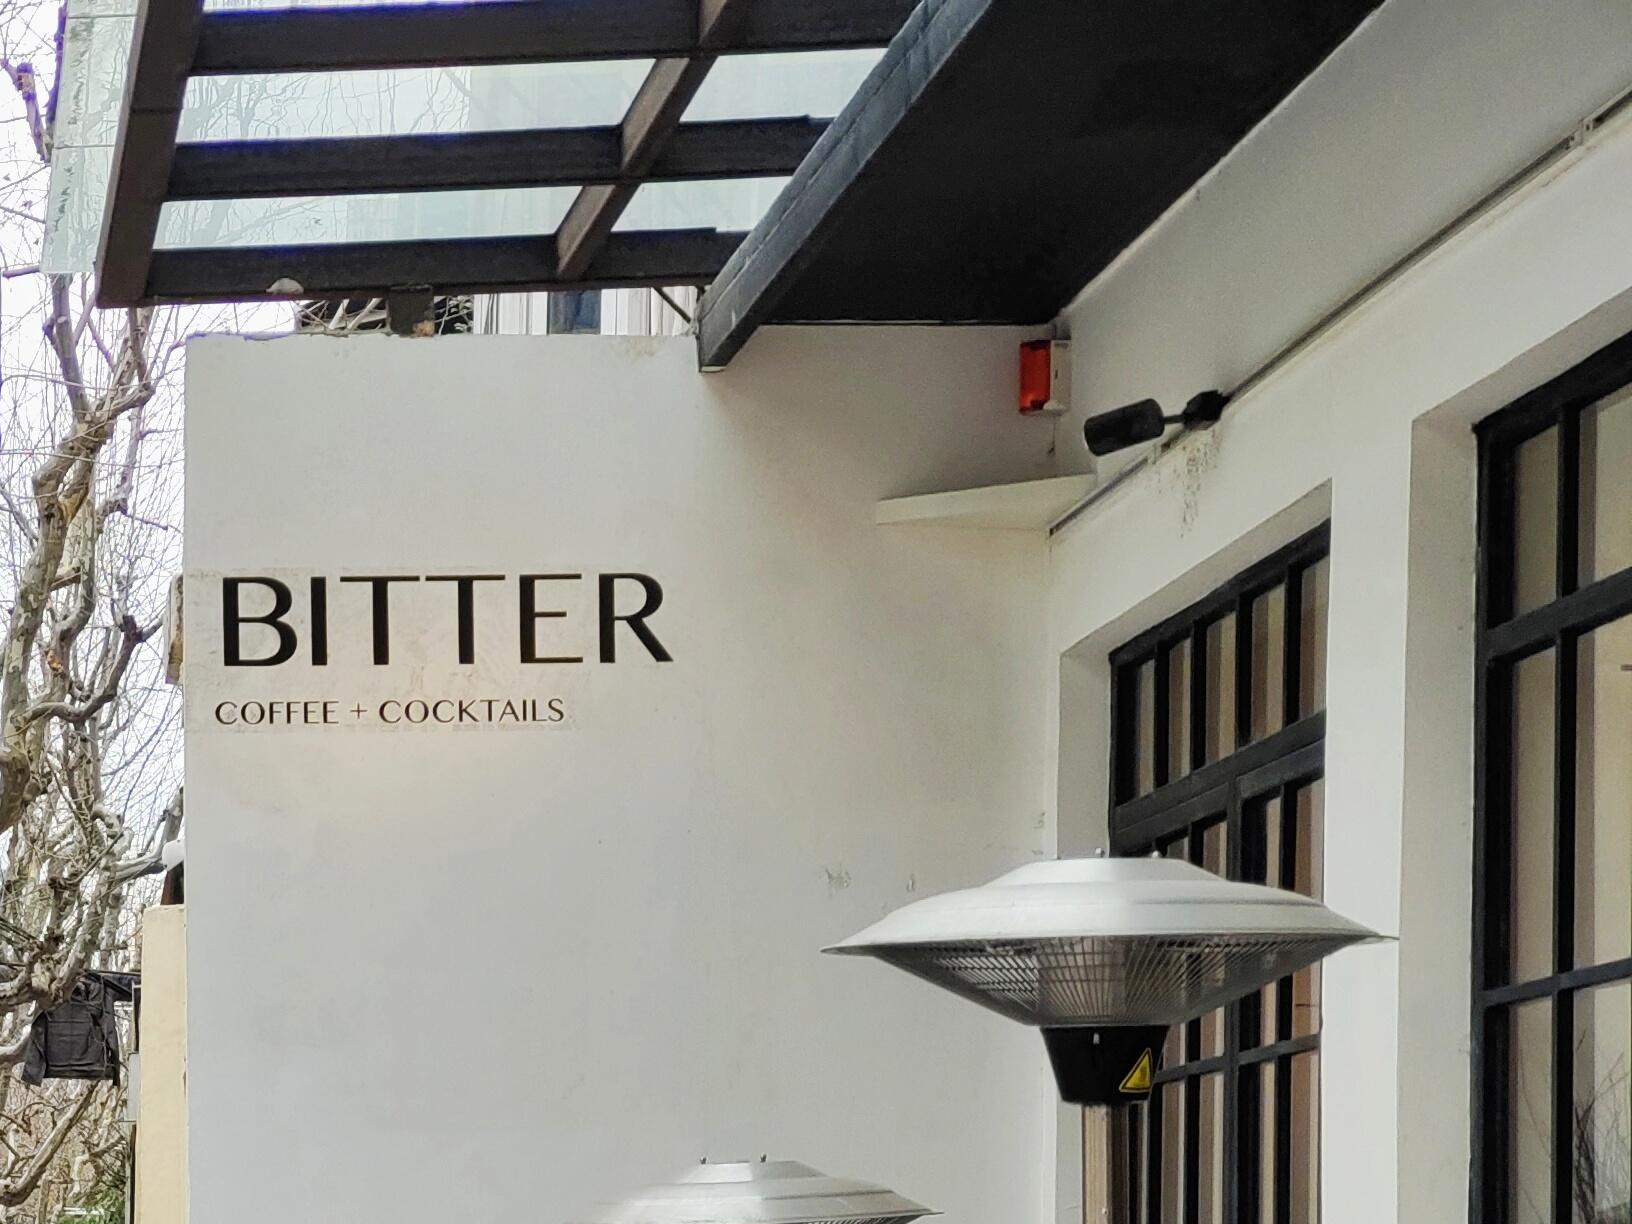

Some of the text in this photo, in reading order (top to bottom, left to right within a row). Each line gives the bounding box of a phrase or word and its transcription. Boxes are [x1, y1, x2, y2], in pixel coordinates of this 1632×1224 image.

[222, 572, 674, 667] BITTER
[214, 700, 339, 725] COFFEE
[378, 698, 565, 724] COCKTAILS
